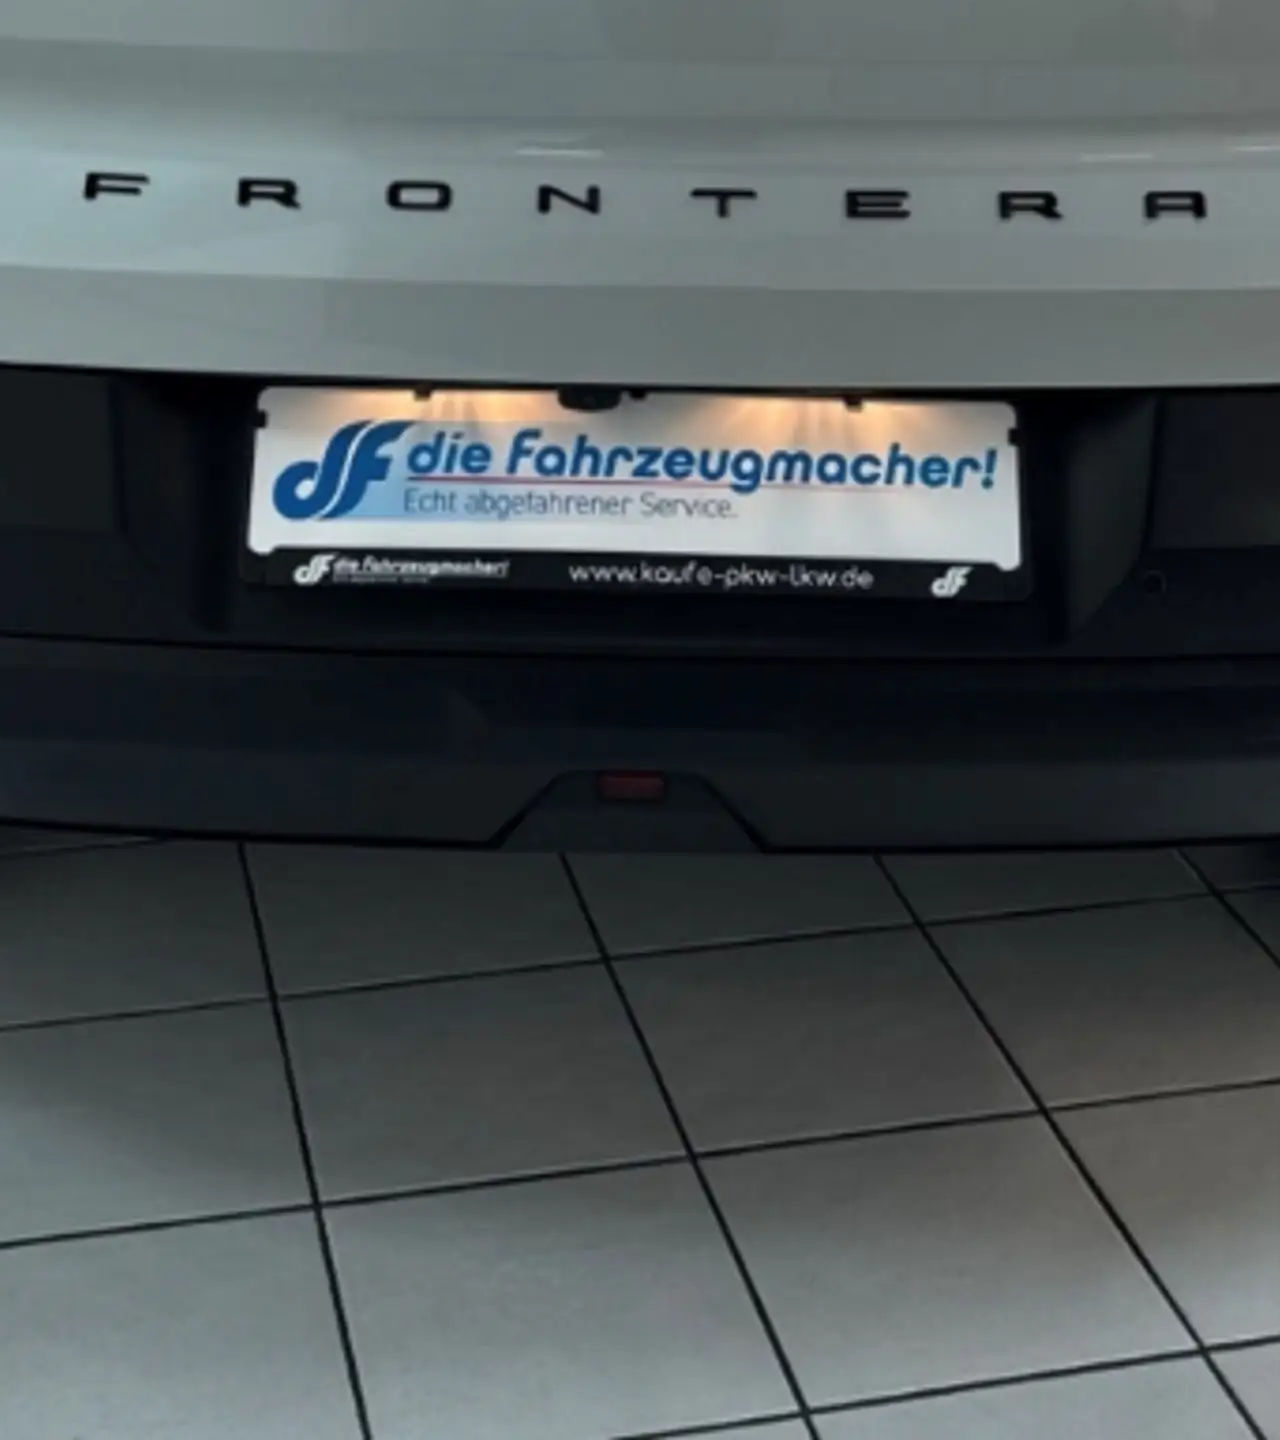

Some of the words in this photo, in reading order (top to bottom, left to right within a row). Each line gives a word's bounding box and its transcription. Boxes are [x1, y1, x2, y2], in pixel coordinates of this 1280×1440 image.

[83, 172, 1208, 221] FRONTERA
[407, 431, 493, 476] die
[505, 429, 997, 494] Fahrzeugmacher!
[404, 487, 458, 513] Echt
[463, 489, 633, 521] abgefahrener
[638, 492, 738, 519] Service.
